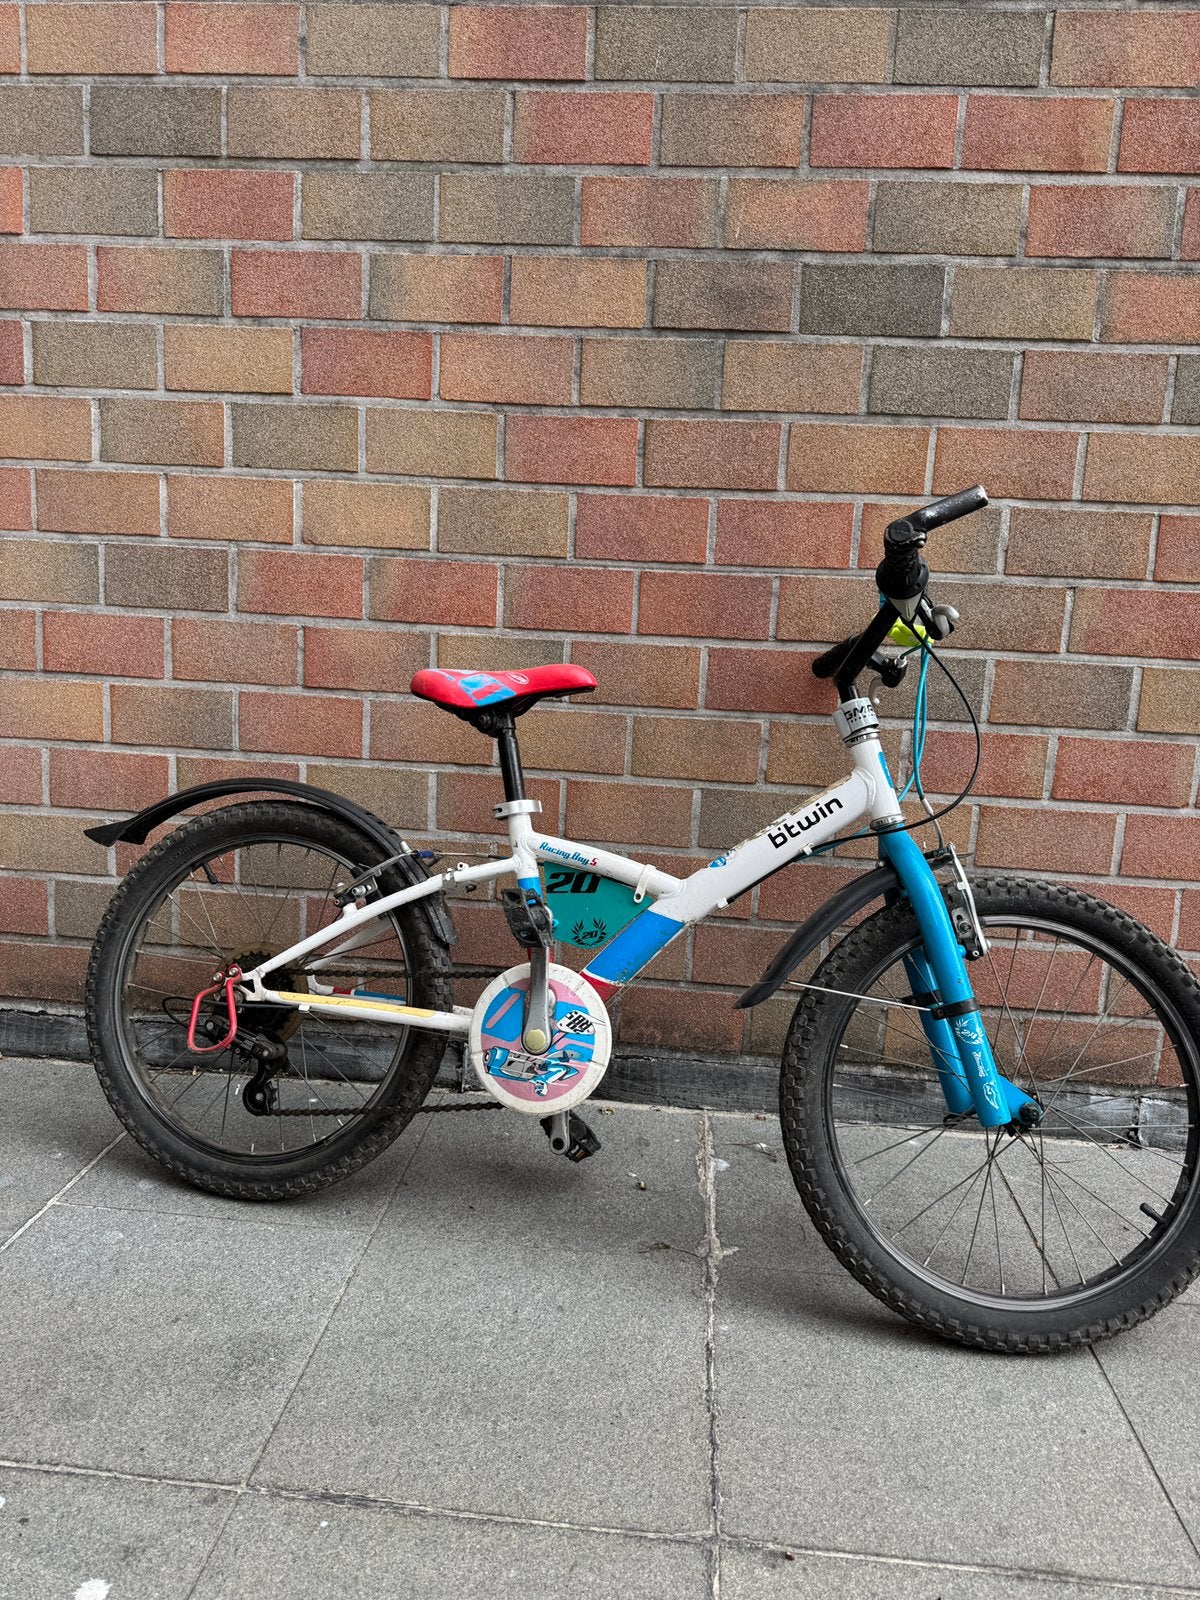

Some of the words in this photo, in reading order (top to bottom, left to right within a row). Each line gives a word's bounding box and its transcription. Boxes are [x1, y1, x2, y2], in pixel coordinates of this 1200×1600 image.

[539, 842, 571, 859] Racing
[571, 852, 590, 866] Boy
[546, 872, 602, 893] 20
[581, 930, 599, 939] 20
